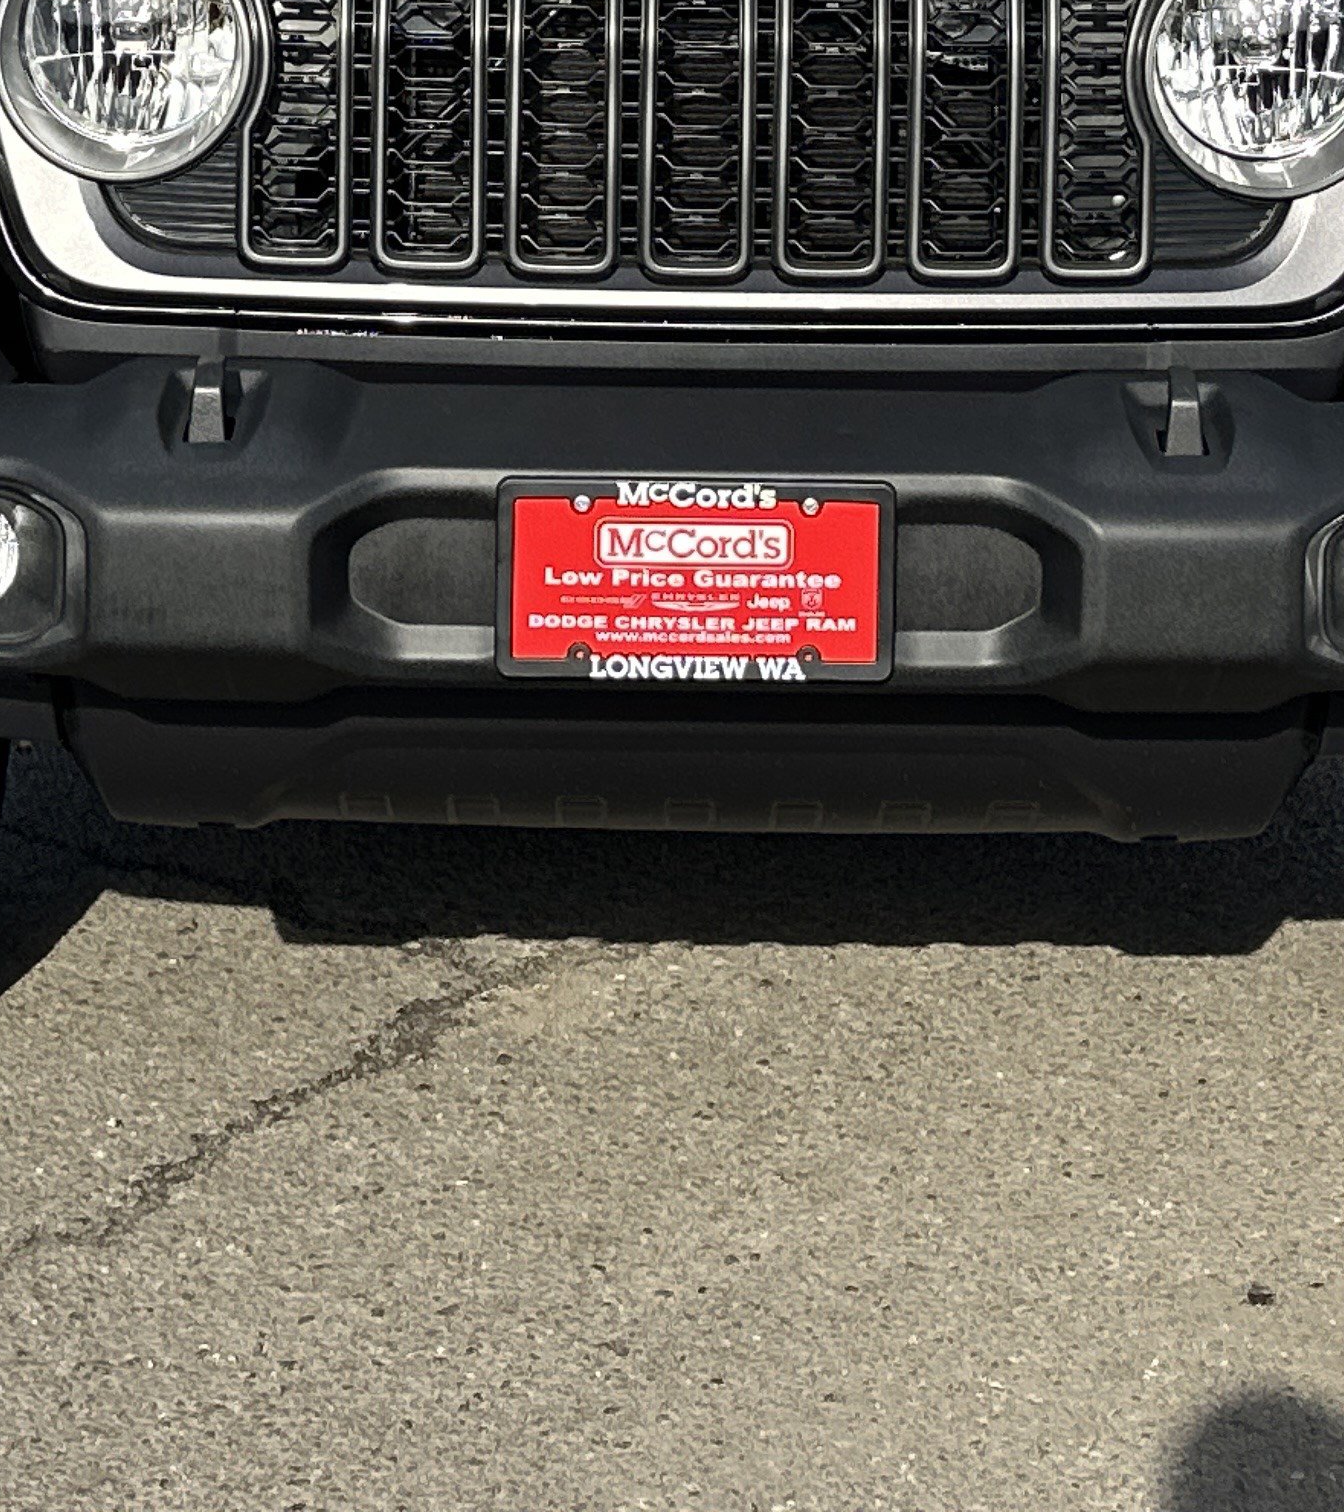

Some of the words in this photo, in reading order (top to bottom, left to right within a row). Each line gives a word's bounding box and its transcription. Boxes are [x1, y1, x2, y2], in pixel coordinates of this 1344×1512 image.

[615, 481, 777, 509] McCord's
[607, 528, 781, 560] McCord's
[544, 567, 603, 586] Low
[611, 569, 685, 587] Price
[693, 570, 842, 589] Guarantee
[746, 593, 791, 612] Jeep
[528, 614, 608, 629] DODGE
[614, 615, 735, 631] CHRYSLER
[742, 617, 799, 632] JEEP
[805, 618, 856, 631] RAM
[589, 654, 749, 680] LONGVIEW
[757, 656, 807, 681] WA
